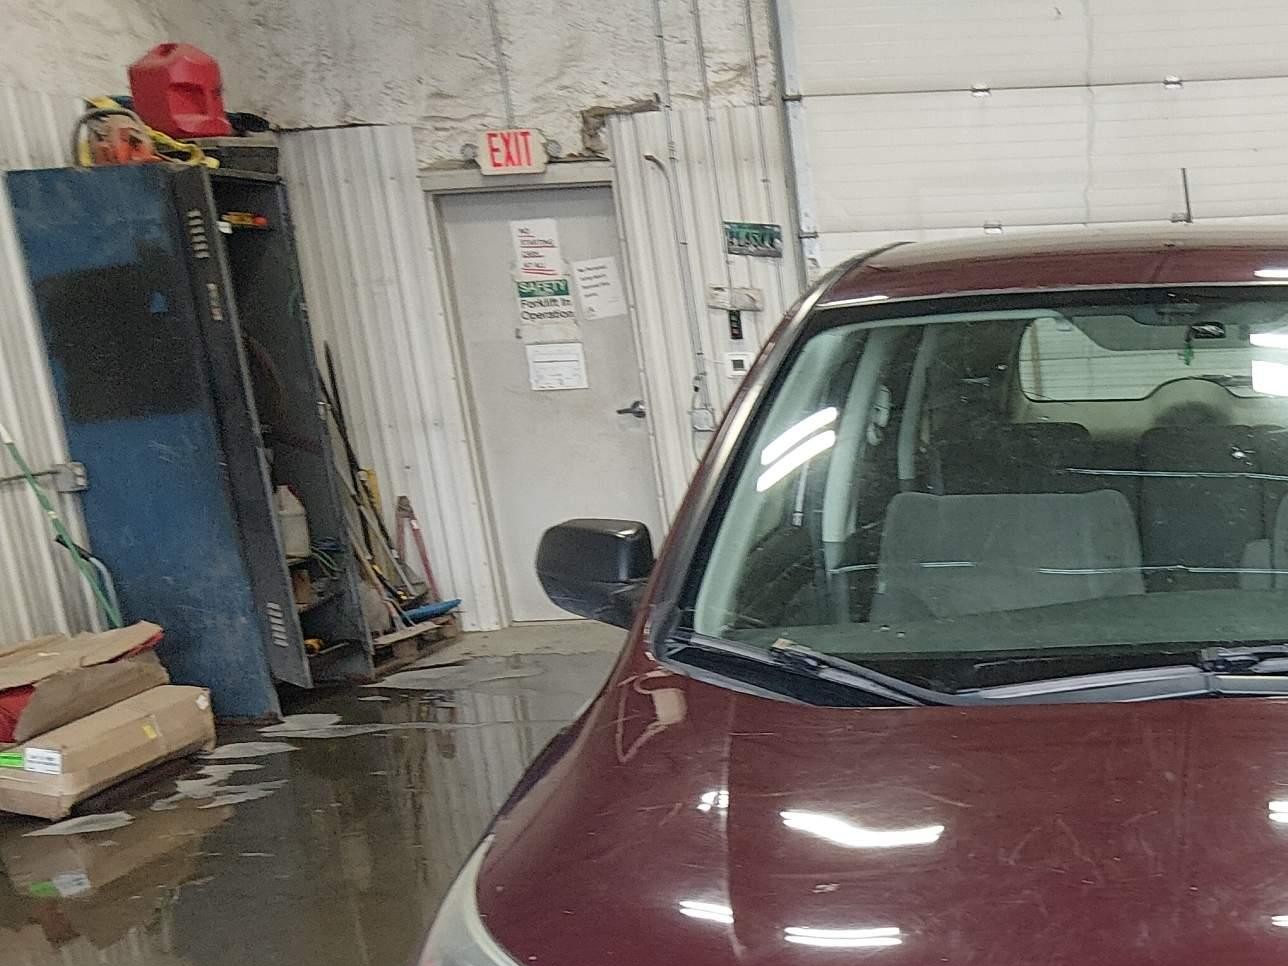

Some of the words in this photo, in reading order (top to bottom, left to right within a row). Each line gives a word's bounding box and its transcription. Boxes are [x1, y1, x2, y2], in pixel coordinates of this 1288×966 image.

[486, 131, 532, 168] EXIT
[519, 281, 567, 296] SAFETY
[520, 298, 560, 308] Forklift
[520, 310, 576, 320] Operation
